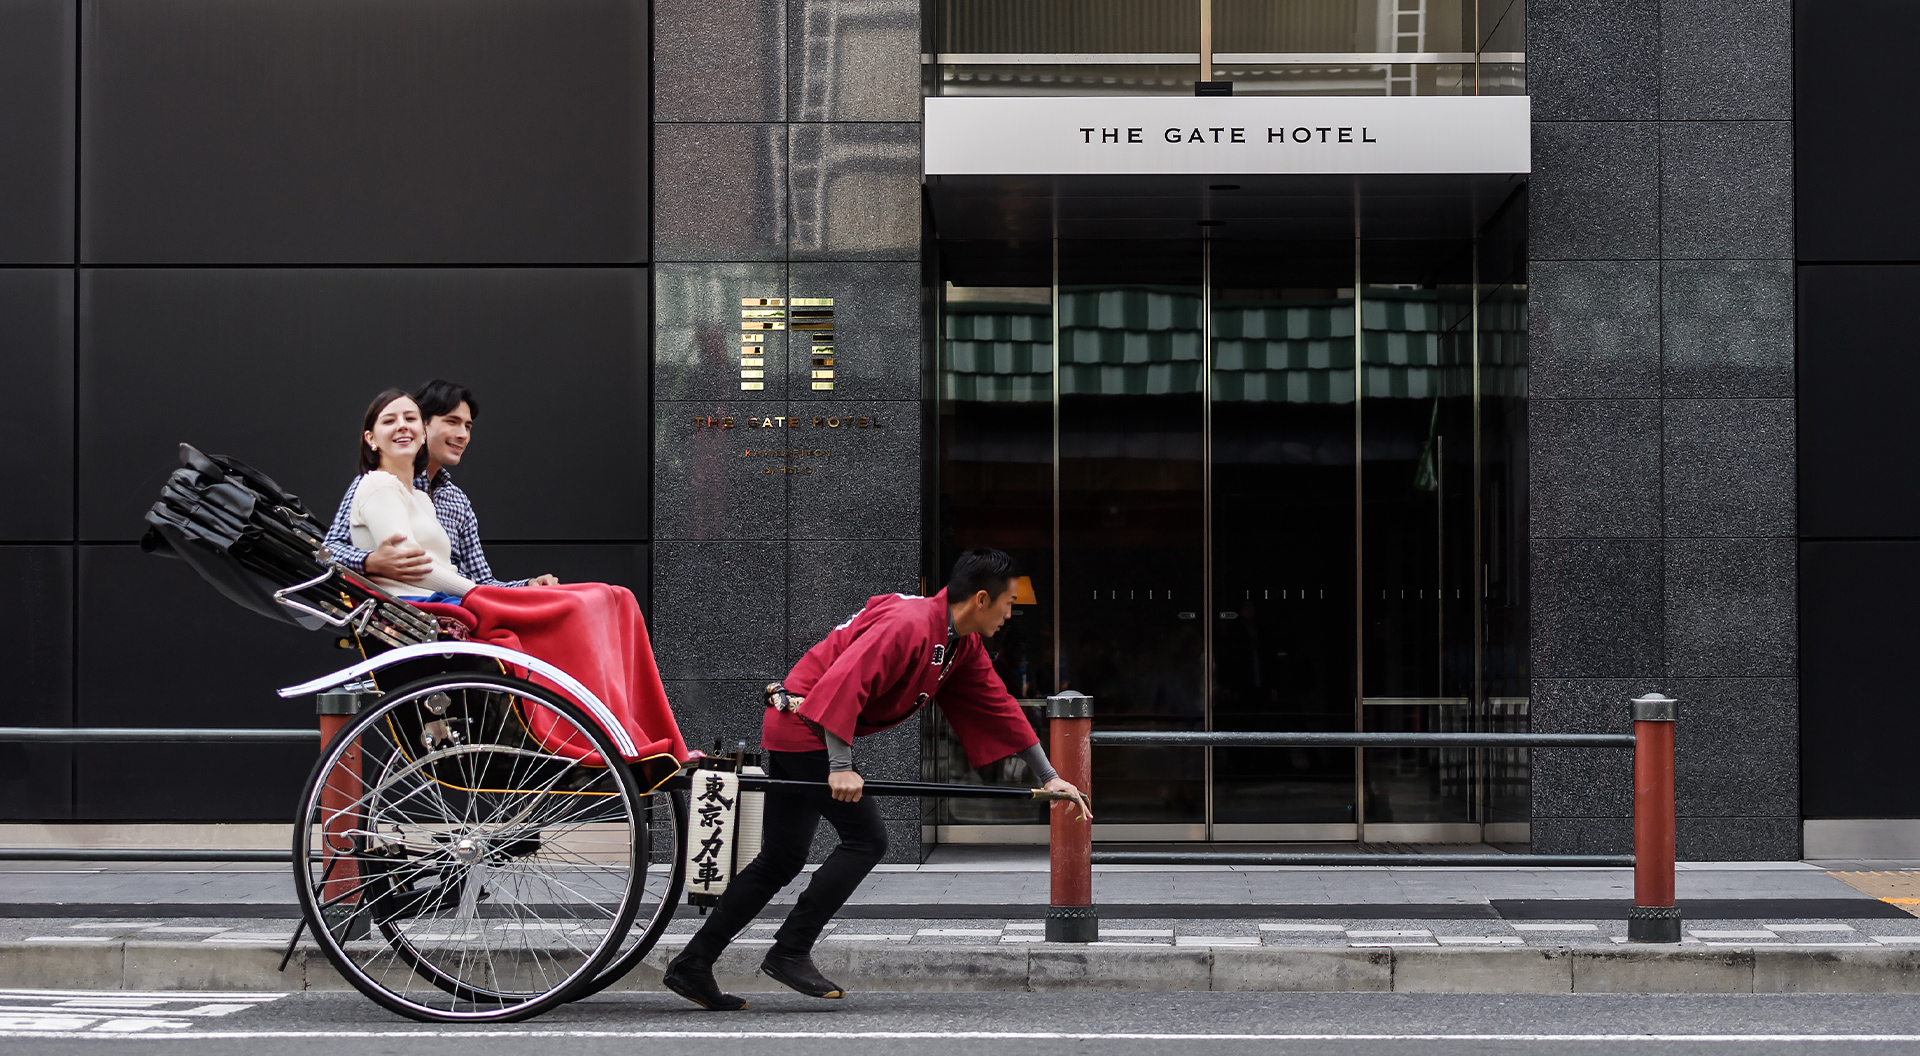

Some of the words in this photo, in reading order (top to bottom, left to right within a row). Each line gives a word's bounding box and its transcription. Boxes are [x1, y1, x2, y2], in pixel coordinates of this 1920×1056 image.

[1079, 127, 1143, 144] THE
[1164, 127, 1246, 144] GATE
[1267, 127, 1377, 144] HOTEL
[693, 416, 734, 428] THE
[747, 416, 800, 428] GATE
[813, 416, 883, 428] HOTEL
[744, 449, 831, 457] KAMINARIMON
[691, 773, 734, 891] 東京力車
